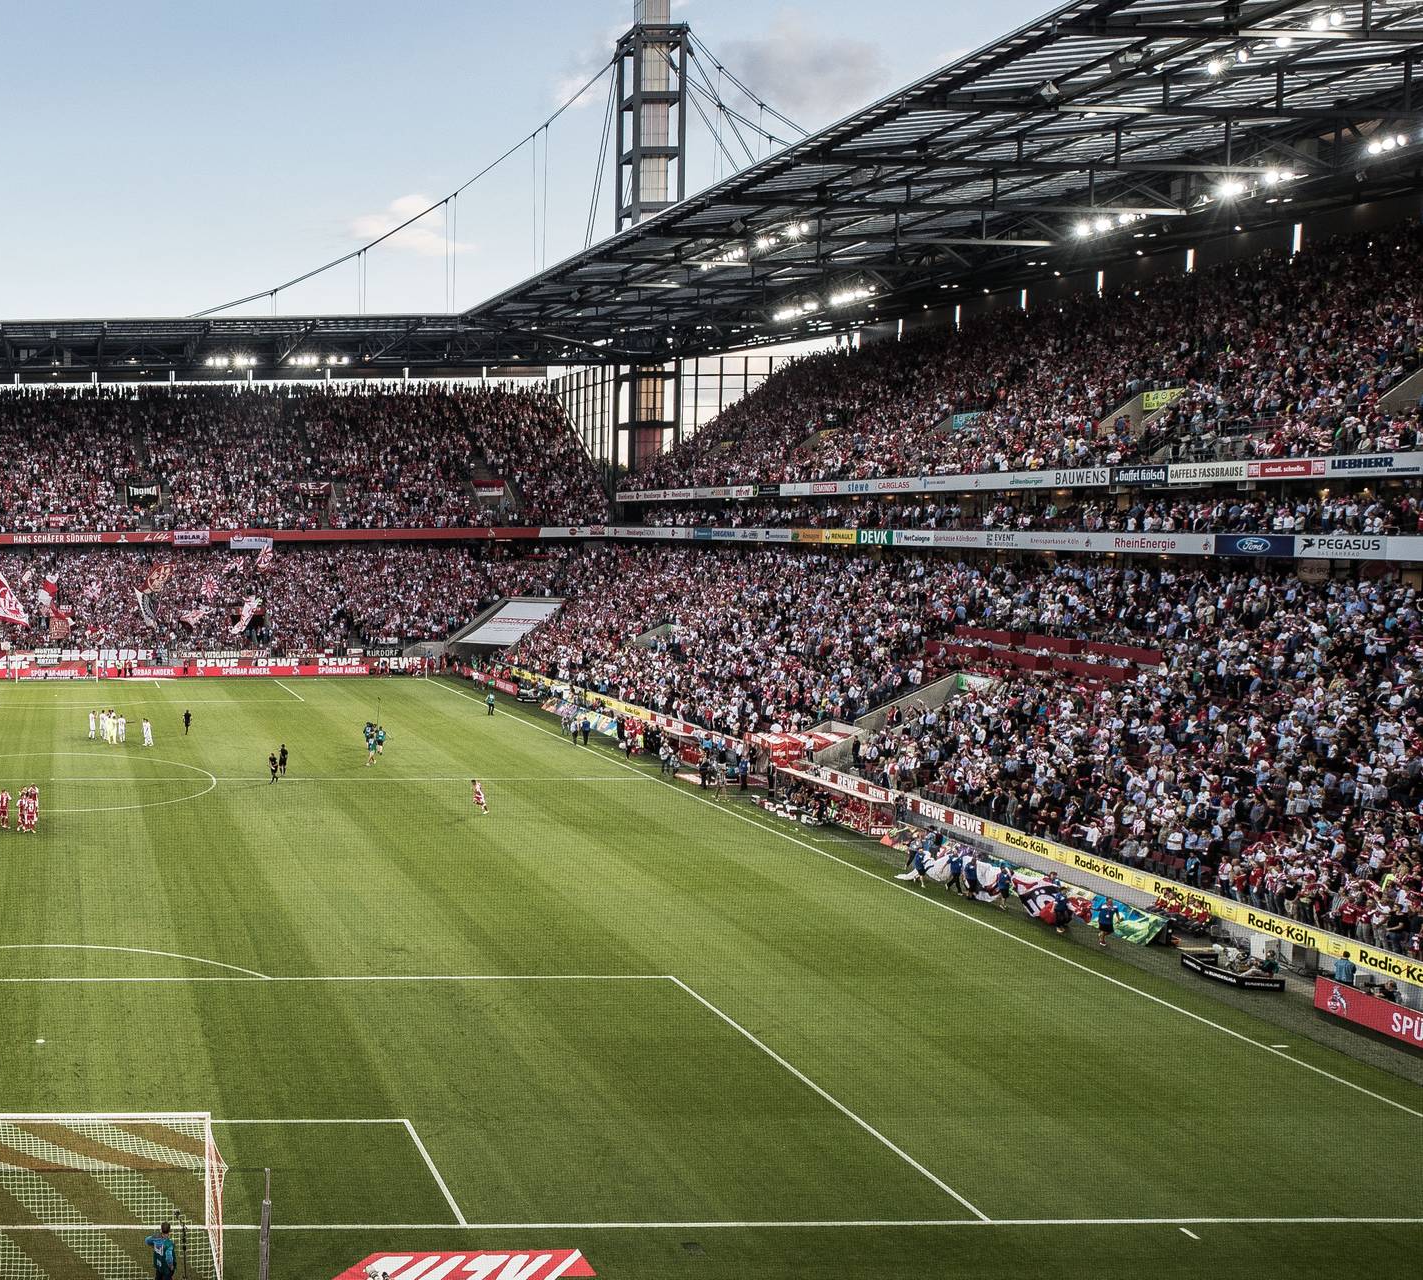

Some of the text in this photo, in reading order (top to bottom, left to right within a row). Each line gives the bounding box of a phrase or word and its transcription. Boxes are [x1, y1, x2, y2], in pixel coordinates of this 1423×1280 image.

[1331, 456, 1394, 470] LIEBHERR
[1055, 470, 1106, 485] BAUWENS
[1170, 466, 1243, 479] GAFFELS FASSBRAUSE
[128, 485, 157, 496] TROIKA
[878, 481, 910, 490] CARGLASS
[13, 533, 102, 544] HANS SCHÄFER SÜDKURVE
[860, 530, 888, 544] DEVK
[994, 534, 1015, 542] EVENT
[1114, 537, 1176, 551] RheinEnergie
[1242, 539, 1264, 551] Ford
[1317, 538, 1381, 551] PEGASUS
[837, 775, 859, 792] REWE
[869, 787, 886, 800] REWE
[919, 802, 946, 823] REWE
[953, 815, 982, 835] REWE
[1005, 833, 1049, 856] Radio Köln
[1074, 855, 1124, 881] Radio Köln
[1248, 913, 1316, 947] Radio Köln
[1359, 949, 1423, 983] Radio Kö
